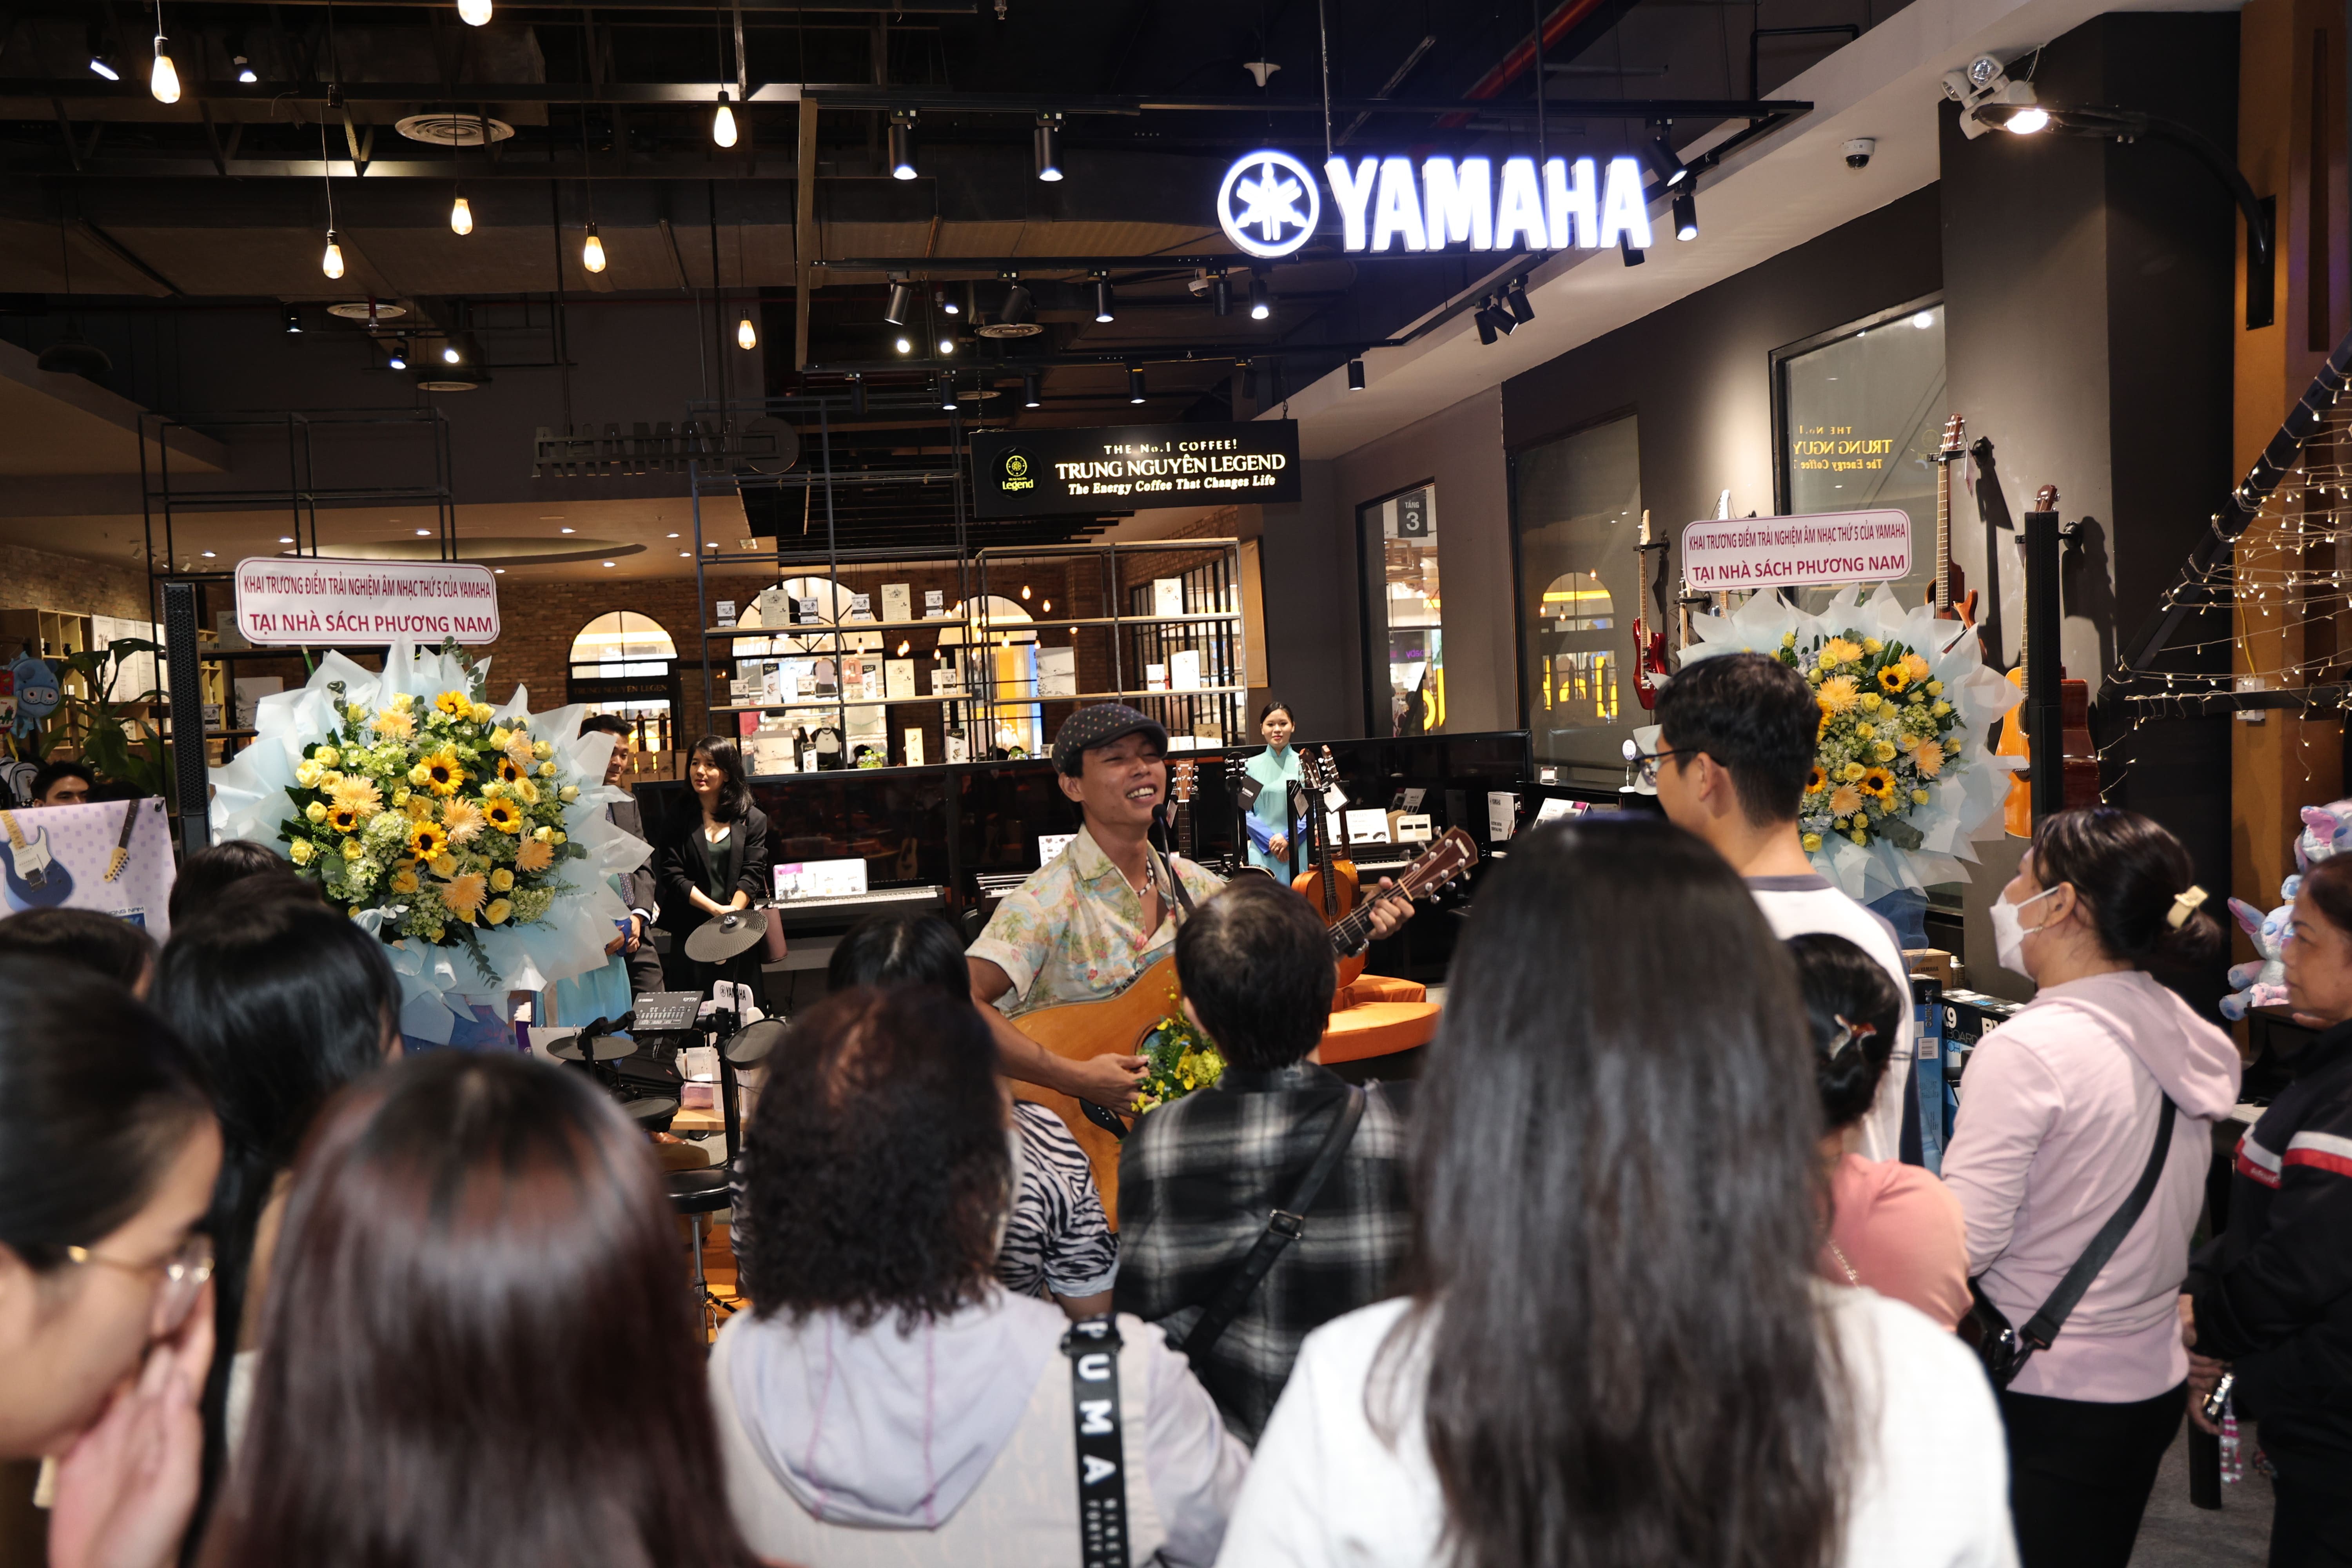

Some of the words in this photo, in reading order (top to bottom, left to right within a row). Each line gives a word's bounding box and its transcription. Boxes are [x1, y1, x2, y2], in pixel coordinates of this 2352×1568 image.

[1325, 156, 1653, 253] YAMAHA
[1103, 445, 1132, 455] THE
[1140, 441, 1171, 453] No.1
[1179, 439, 1237, 451] COFFEE!
[1055, 461, 1123, 479] TRUNG
[1127, 454, 1207, 476] NGUYÊN
[1210, 454, 1286, 473] LEGEND
[1002, 479, 1034, 491] Legend
[1068, 483, 1089, 495] The
[1093, 483, 1132, 495] Energy
[1135, 479, 1172, 492] Coffee
[1176, 478, 1200, 490] That
[1204, 477, 1249, 490] Changes
[1252, 474, 1275, 486] Life
[1406, 512, 1419, 530] 3
[1689, 535, 1705, 550] KHAI
[1707, 533, 1737, 549] TRƯƠNG
[1739, 526, 1756, 548] ĐIỂM
[1758, 526, 1773, 546] TRẢI
[1775, 526, 1802, 548] NGHIỆM
[1804, 525, 1815, 543] ÂM
[1817, 527, 1836, 545] NHẠC
[1838, 523, 1853, 541] THỨ
[1855, 526, 1858, 541] 5
[1860, 520, 1874, 540] CỦA
[1876, 523, 1905, 539] YAMAHA
[1693, 566, 1714, 583] TẠI
[1719, 560, 1751, 579] NHÀ
[1755, 559, 1792, 577] SÁCH
[1797, 557, 1864, 575] PHƯƠNG
[1869, 555, 1904, 571] NAM
[244, 575, 264, 593] KHAI
[266, 575, 303, 594] TRƯƠNG
[305, 570, 327, 595] ĐIỂM
[328, 571, 346, 595] TRẢI
[348, 574, 380, 599] NGHIỆM
[382, 573, 394, 596] ÂM
[397, 580, 417, 601] NHẠC
[419, 576, 436, 597] THỨ
[437, 581, 441, 597] 5
[443, 575, 458, 598] CỦA
[460, 582, 491, 599] YAMAHA
[249, 614, 276, 635] TẠI
[283, 610, 321, 631] NHÀ
[326, 610, 369, 632] SÁCH
[374, 615, 449, 632] PHƯƠNG
[454, 617, 493, 632] NAM
[726, 987, 746, 1001] YAHA
